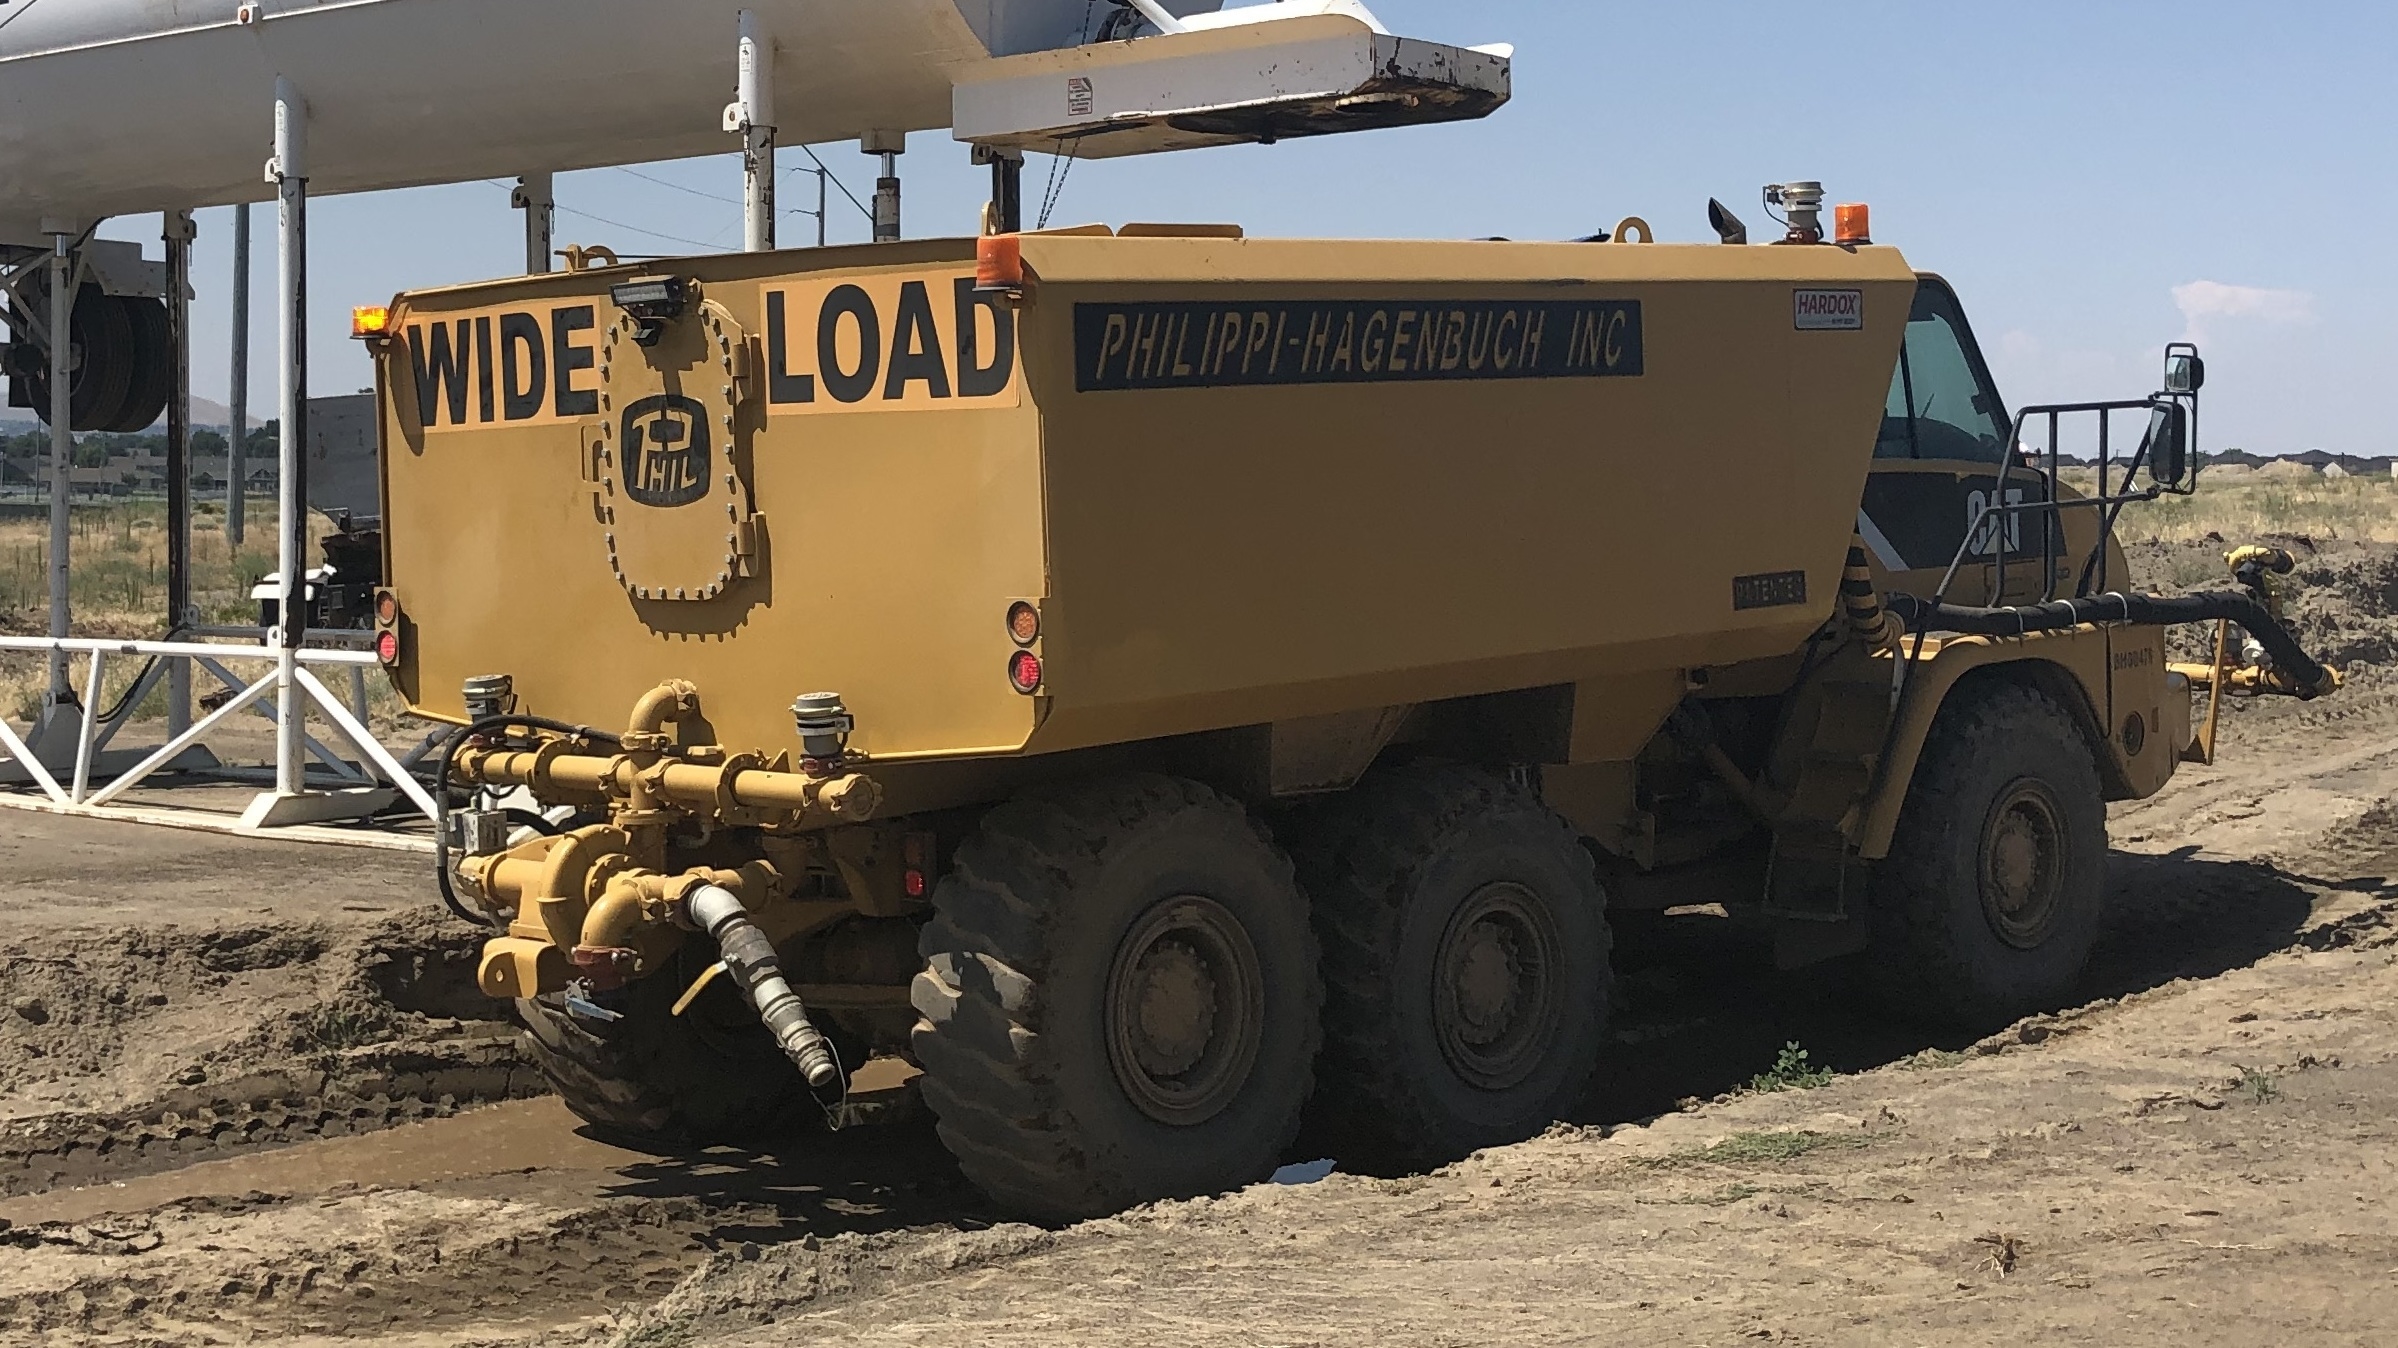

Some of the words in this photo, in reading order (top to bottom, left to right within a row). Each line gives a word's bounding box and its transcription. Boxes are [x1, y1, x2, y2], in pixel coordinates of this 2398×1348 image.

[1798, 294, 1856, 315] HARDOX
[406, 304, 599, 427] WIDE
[766, 277, 1014, 405] LOAD
[1096, 310, 1544, 380] PHILIPPI-HAGENBUCH
[1566, 310, 1626, 367] INC
[632, 409, 698, 492] PHIL
